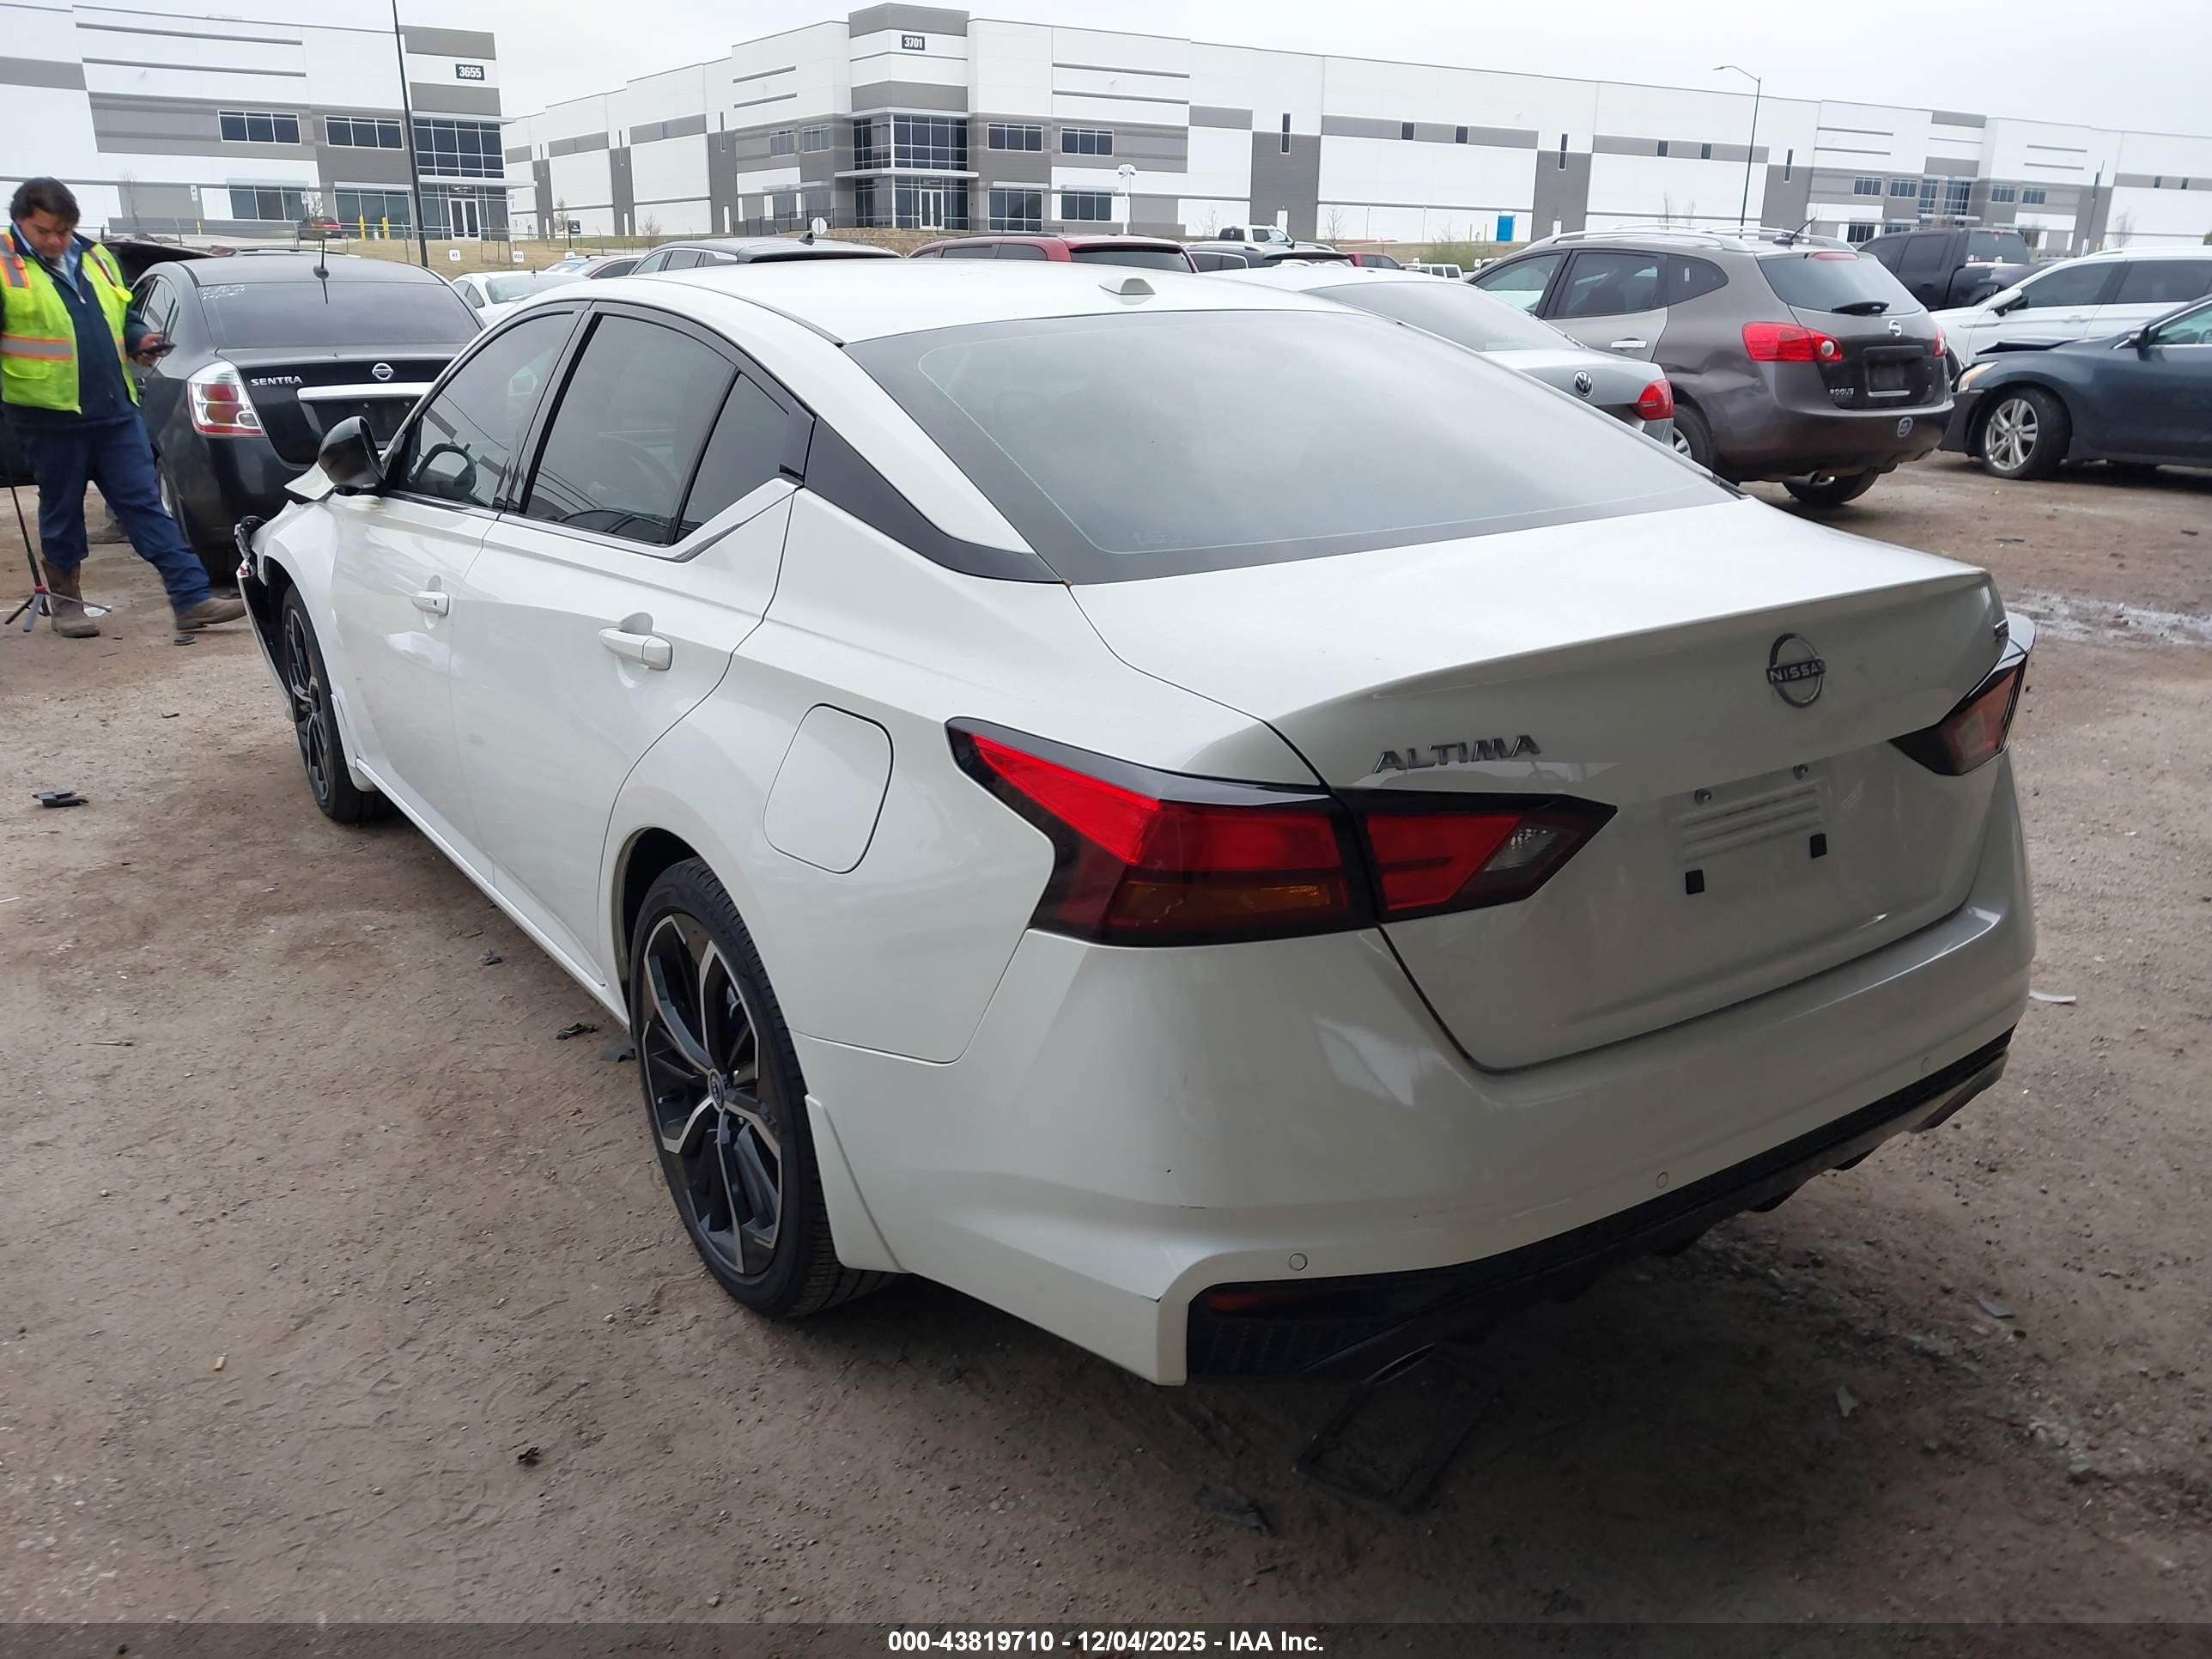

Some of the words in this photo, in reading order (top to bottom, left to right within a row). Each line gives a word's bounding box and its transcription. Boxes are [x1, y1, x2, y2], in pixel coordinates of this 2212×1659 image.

[904, 37, 923, 48] 3701
[459, 66, 482, 77] 3655
[251, 376, 302, 386] SENTRA
[1373, 735, 1541, 774] ALTIMA
